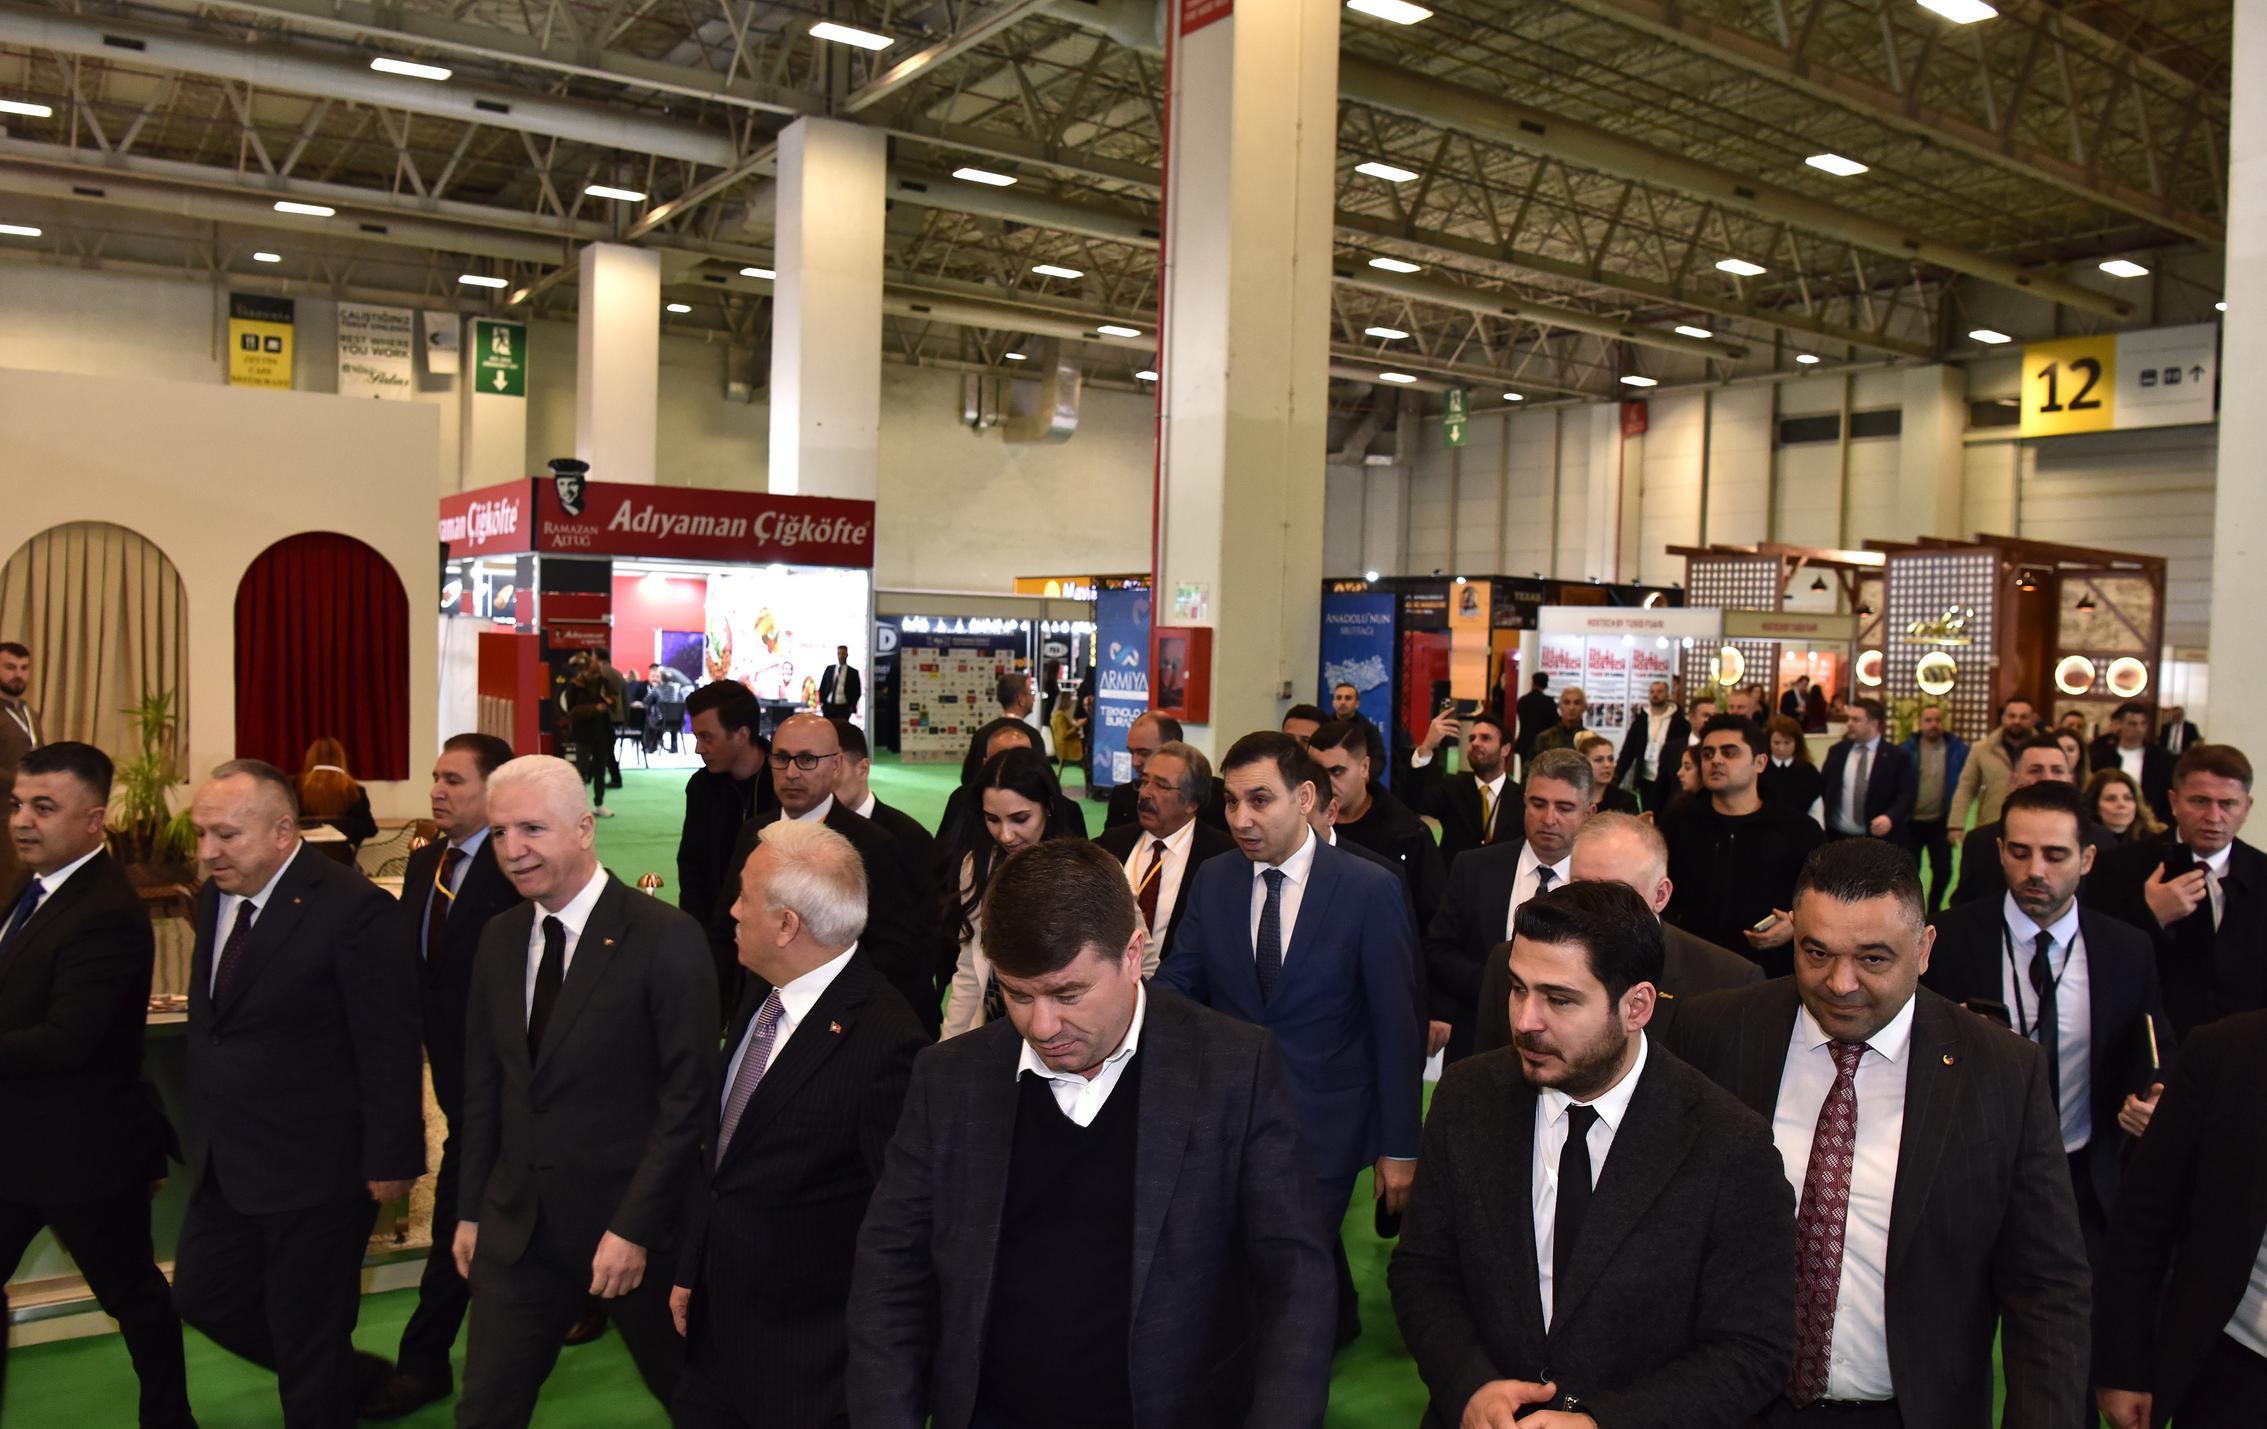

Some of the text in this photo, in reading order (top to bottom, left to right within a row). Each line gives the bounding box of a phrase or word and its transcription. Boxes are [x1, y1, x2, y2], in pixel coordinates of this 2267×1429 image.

[342, 345, 409, 358] YOU WORK
[371, 338, 409, 348] WHERE
[2037, 356, 2102, 413] 12
[467, 498, 518, 547] Çiğköfte
[543, 521, 599, 535] RAMAZAN
[608, 499, 868, 547] Adıyaman Çiğköfte
